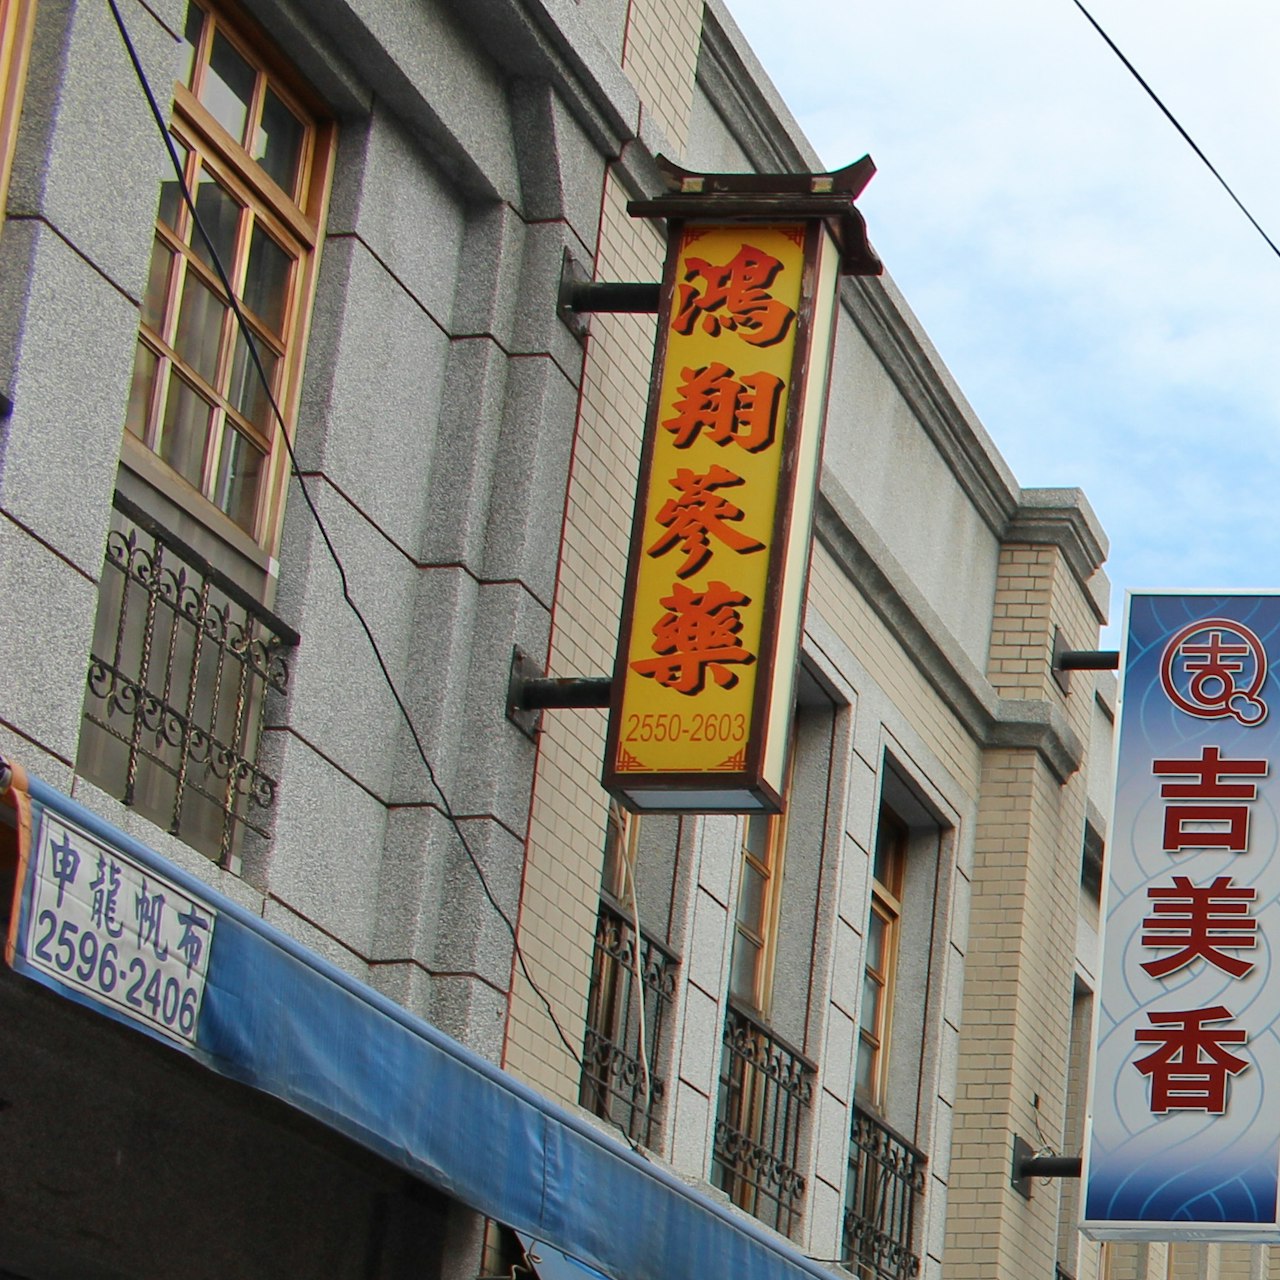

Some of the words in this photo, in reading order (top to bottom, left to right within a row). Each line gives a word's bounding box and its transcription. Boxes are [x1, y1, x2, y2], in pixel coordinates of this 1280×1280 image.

[630, 242, 797, 697] 鴻翔蔘藥
[625, 711, 747, 745] 2550-2603
[49, 831, 209, 980] 申龍帆布
[1131, 745, 1269, 1116] 吉美香
